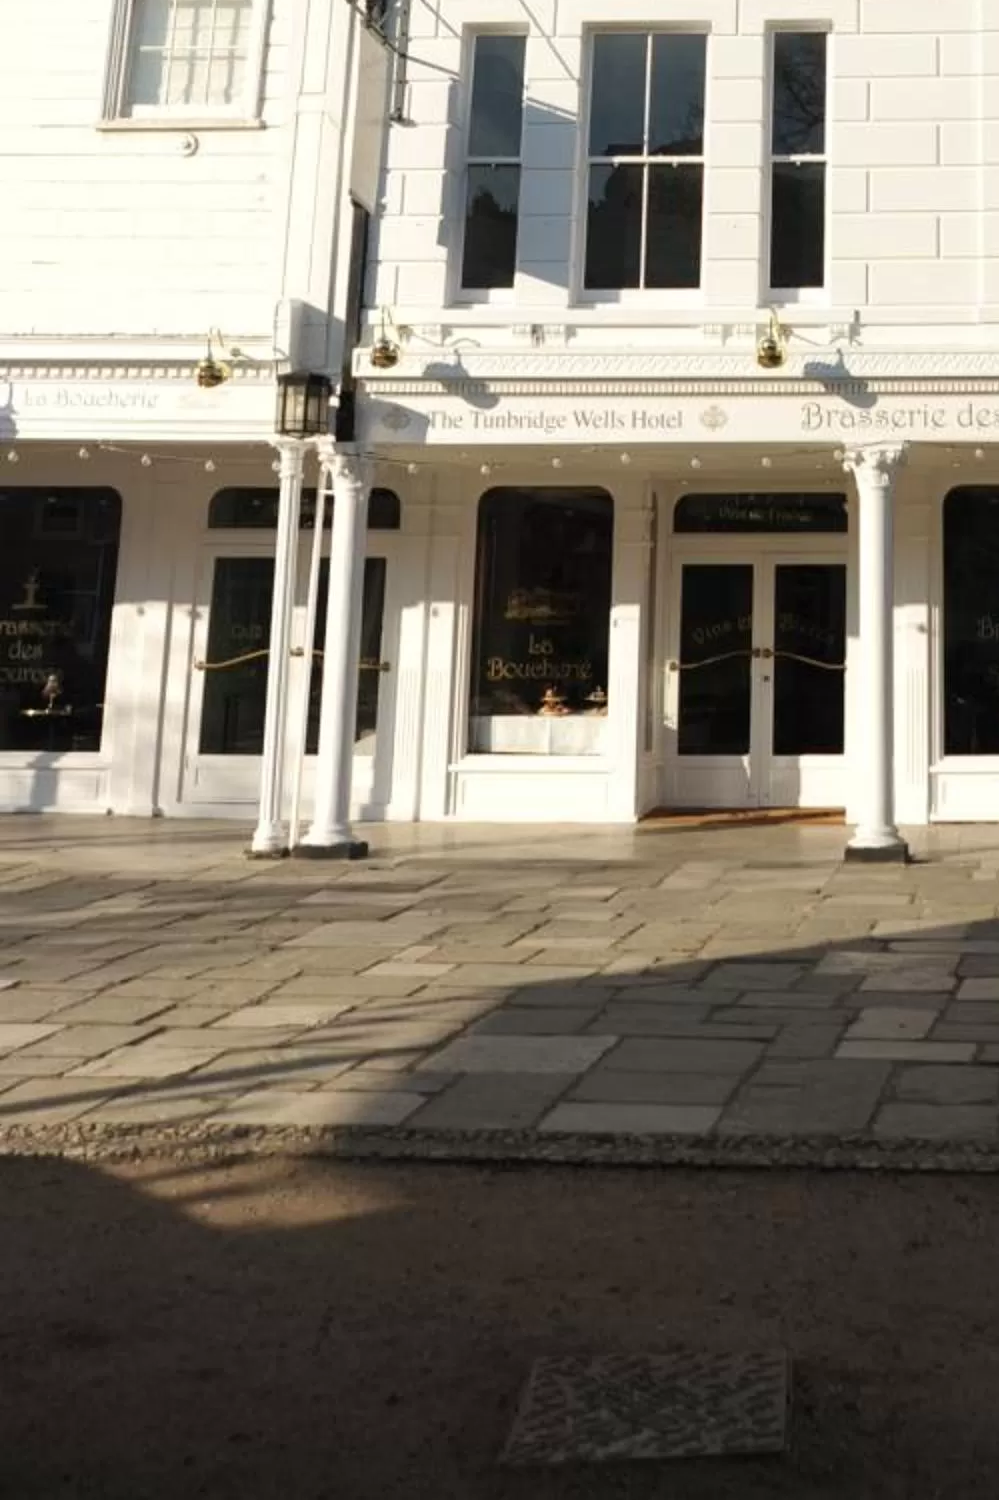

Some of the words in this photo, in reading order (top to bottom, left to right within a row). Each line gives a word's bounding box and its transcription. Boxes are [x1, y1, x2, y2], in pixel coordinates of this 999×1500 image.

[23, 388, 48, 408] La
[53, 387, 159, 409] Boucherie
[428, 409, 463, 429] The
[469, 409, 567, 433] Tunbridge
[572, 409, 625, 429] Wells
[631, 409, 684, 429] Hotel
[800, 402, 946, 431] Brasserie
